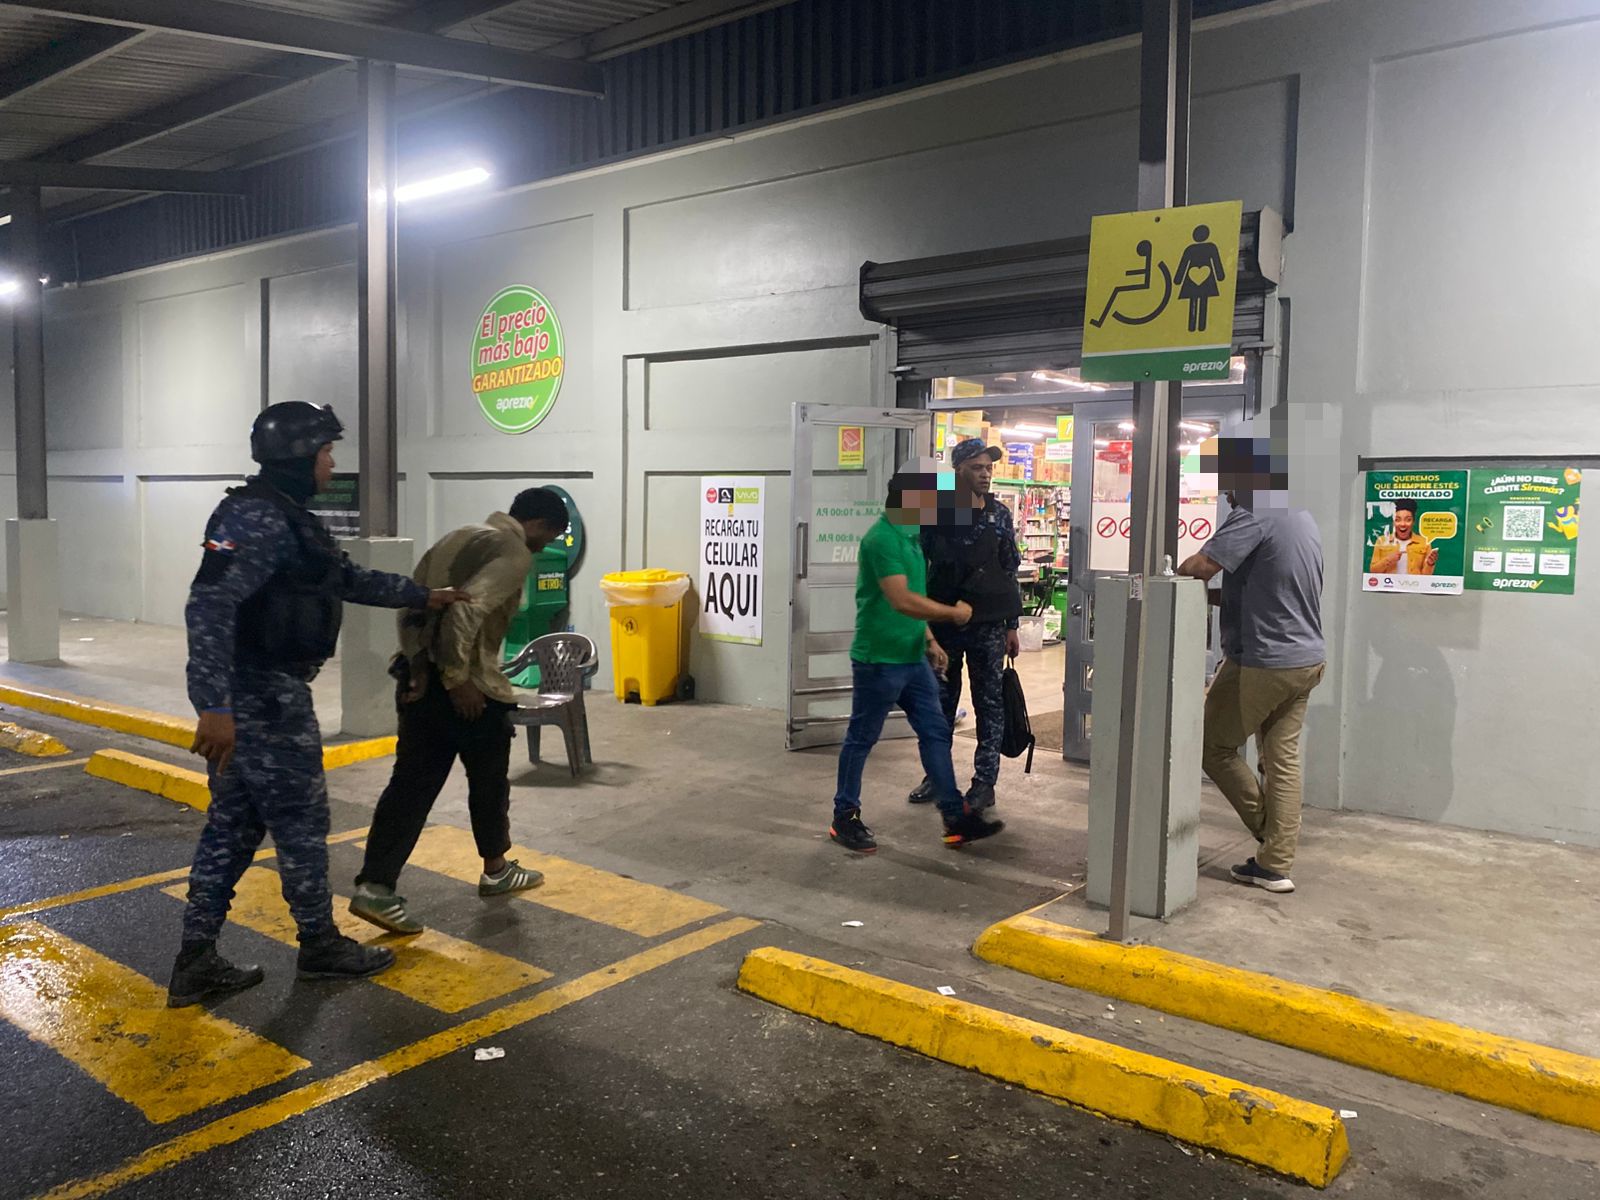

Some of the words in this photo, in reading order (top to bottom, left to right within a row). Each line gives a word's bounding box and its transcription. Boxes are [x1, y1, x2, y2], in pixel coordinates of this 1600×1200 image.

[481, 312, 496, 338] El
[498, 302, 546, 341] precio
[478, 339, 510, 365] más
[514, 328, 549, 361] bajo
[472, 357, 563, 393] GARANTIZADO
[1182, 360, 1229, 374] aprezio
[496, 396, 539, 413] aprezio
[1484, 484, 1520, 494] CLIENTE
[1490, 474, 1515, 486] ¿AÚN
[1533, 475, 1559, 485] ERES
[705, 519, 745, 537] RECARGA
[747, 520, 759, 537] TU
[705, 542, 758, 567] CELULAR
[1492, 578, 1544, 590] aprezio
[704, 572, 757, 622] AQUI
